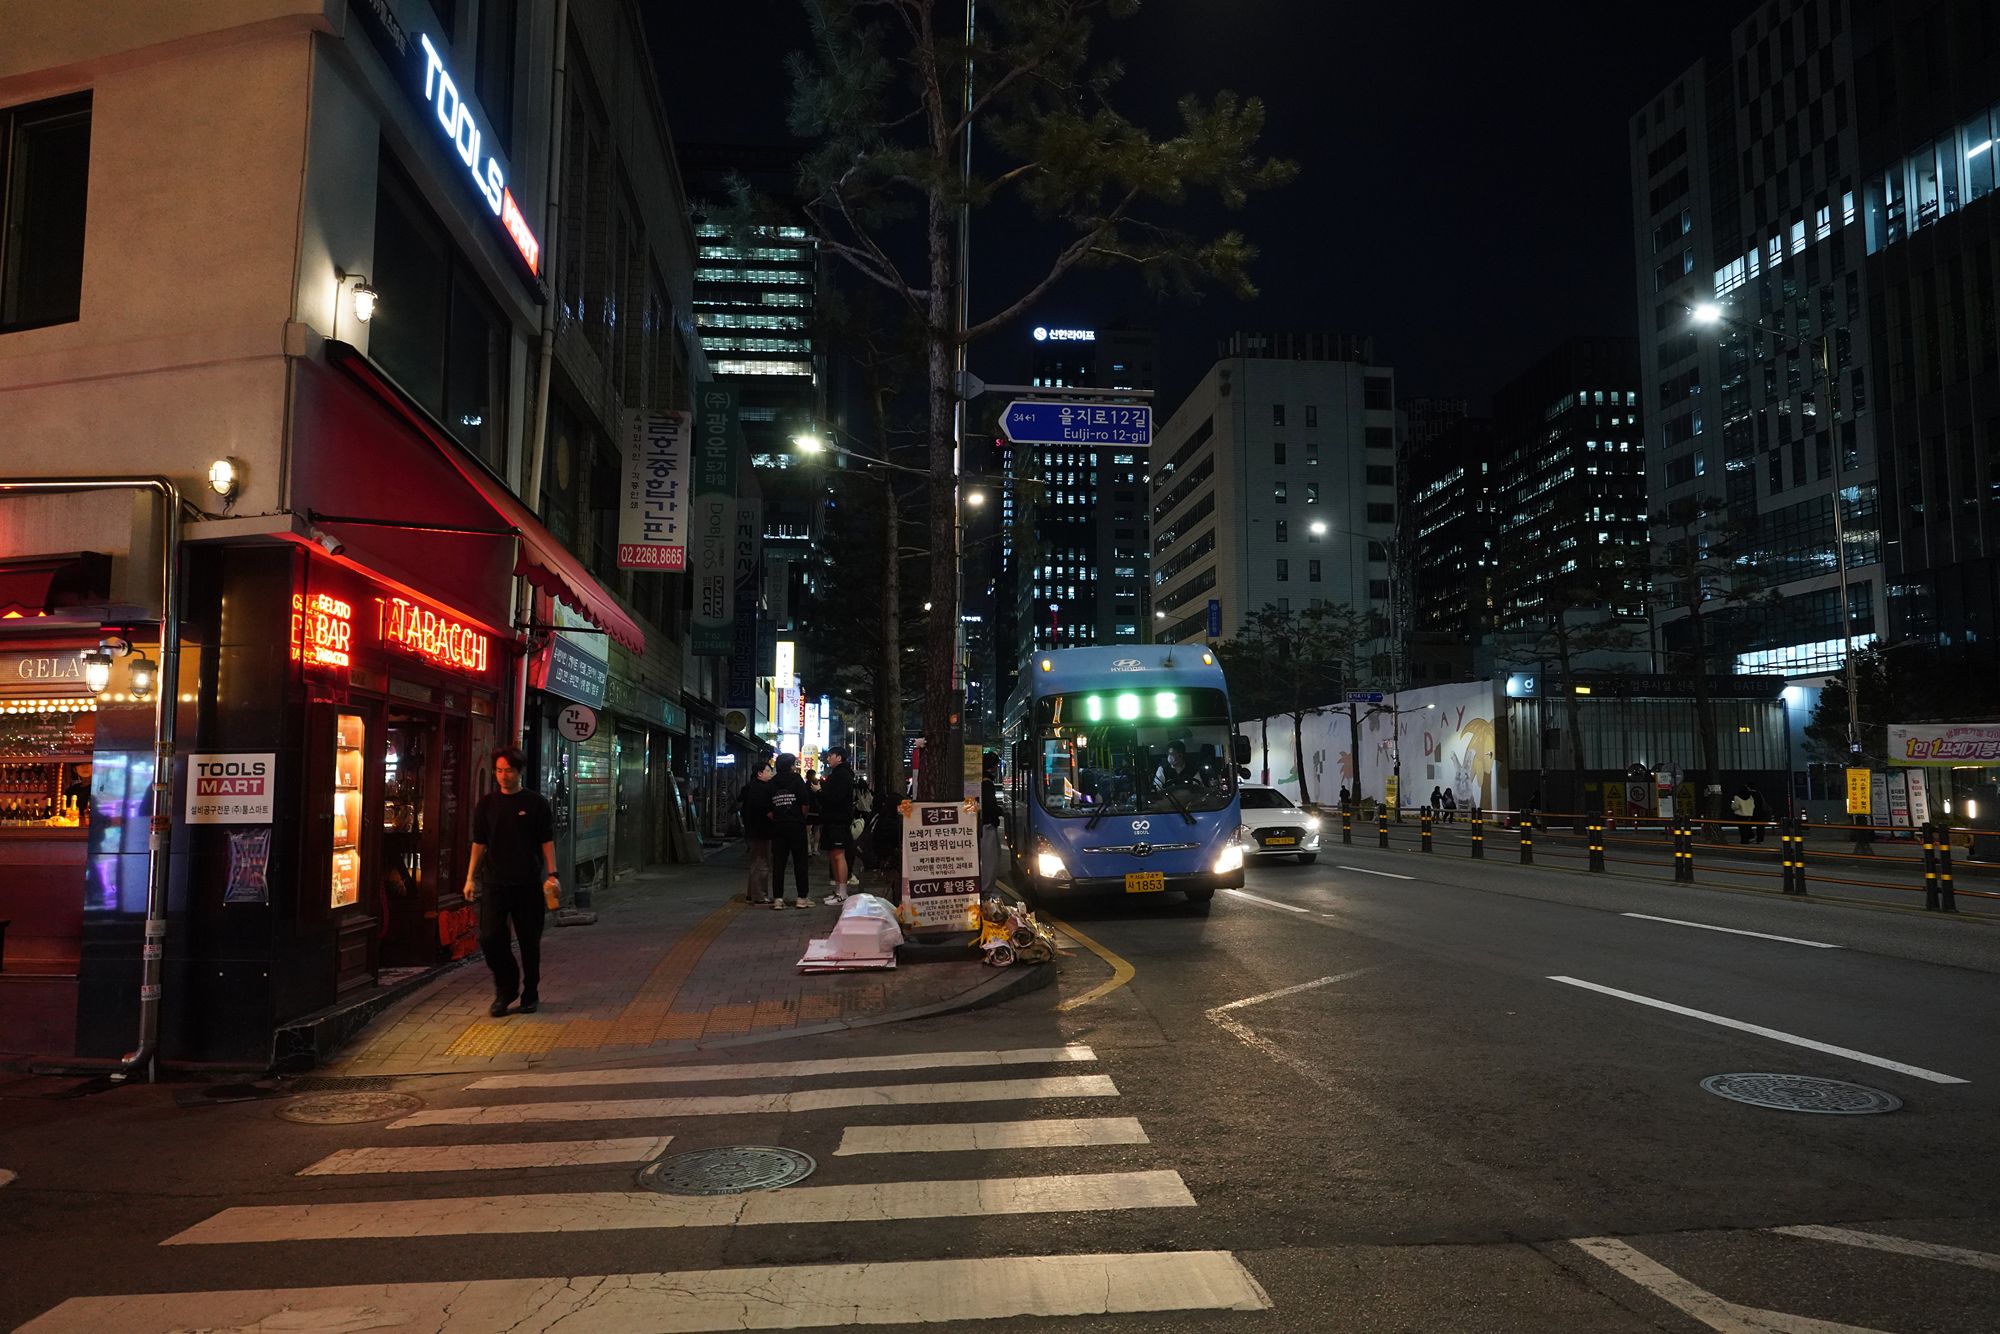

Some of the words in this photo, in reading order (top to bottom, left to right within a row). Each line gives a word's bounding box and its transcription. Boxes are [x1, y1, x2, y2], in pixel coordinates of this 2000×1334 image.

[421, 33, 504, 216] TOOLS
[506, 196, 536, 265] MART
[1049, 329, 1095, 340] 신한라이프
[1059, 407, 1146, 428] 을지로12길
[1064, 428, 1109, 442] Eulji-ro
[1113, 433, 1146, 446] 12-gil
[644, 416, 679, 542] 금호종합간판
[317, 615, 350, 651] BAR
[393, 598, 488, 671] TABACCHI
[18, 658, 81, 679] GELA
[564, 709, 590, 737] 간판
[197, 762, 266, 777] TOOLS
[200, 780, 262, 794] MART
[190, 805, 230, 816] 설비공구전문
[928, 808, 956, 823] 경고
[908, 829, 931, 838] 쓰레기
[935, 827, 974, 837] 무단투기는
[910, 839, 975, 852] 범죄행위입니다.
[913, 882, 940, 894] CCTV
[1137, 878, 1163, 891] 1853
